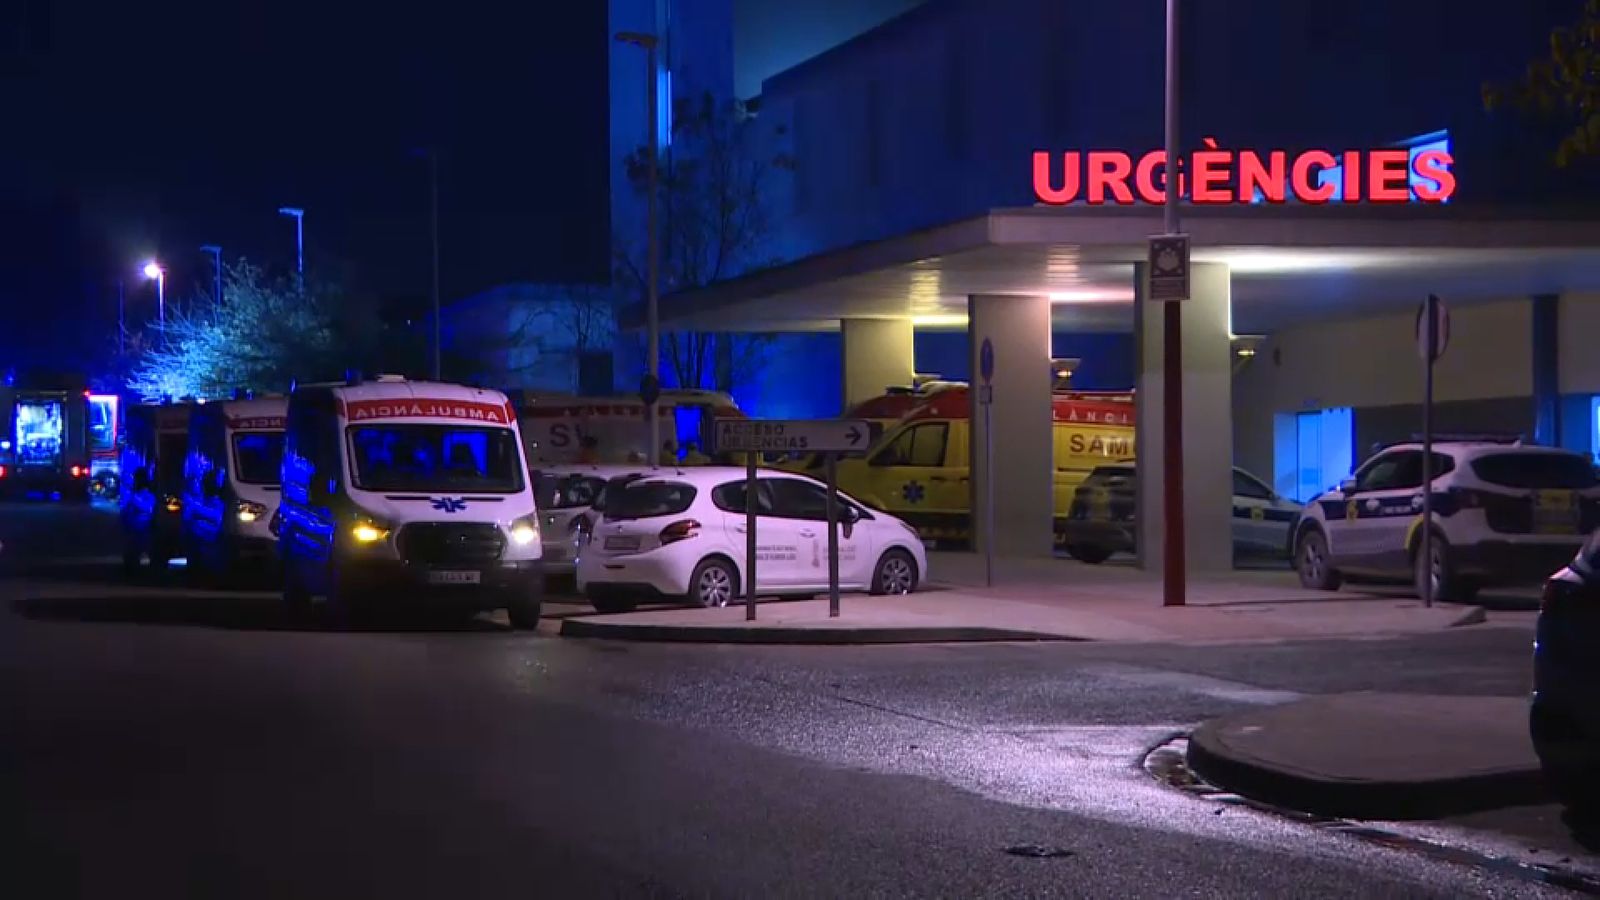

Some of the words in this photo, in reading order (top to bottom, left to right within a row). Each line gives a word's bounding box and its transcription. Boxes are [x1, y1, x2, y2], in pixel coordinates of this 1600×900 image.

[1032, 136, 1456, 205] URGÈNCIES
[723, 423, 785, 436] ACCESO
[1069, 433, 1136, 456] SAM
